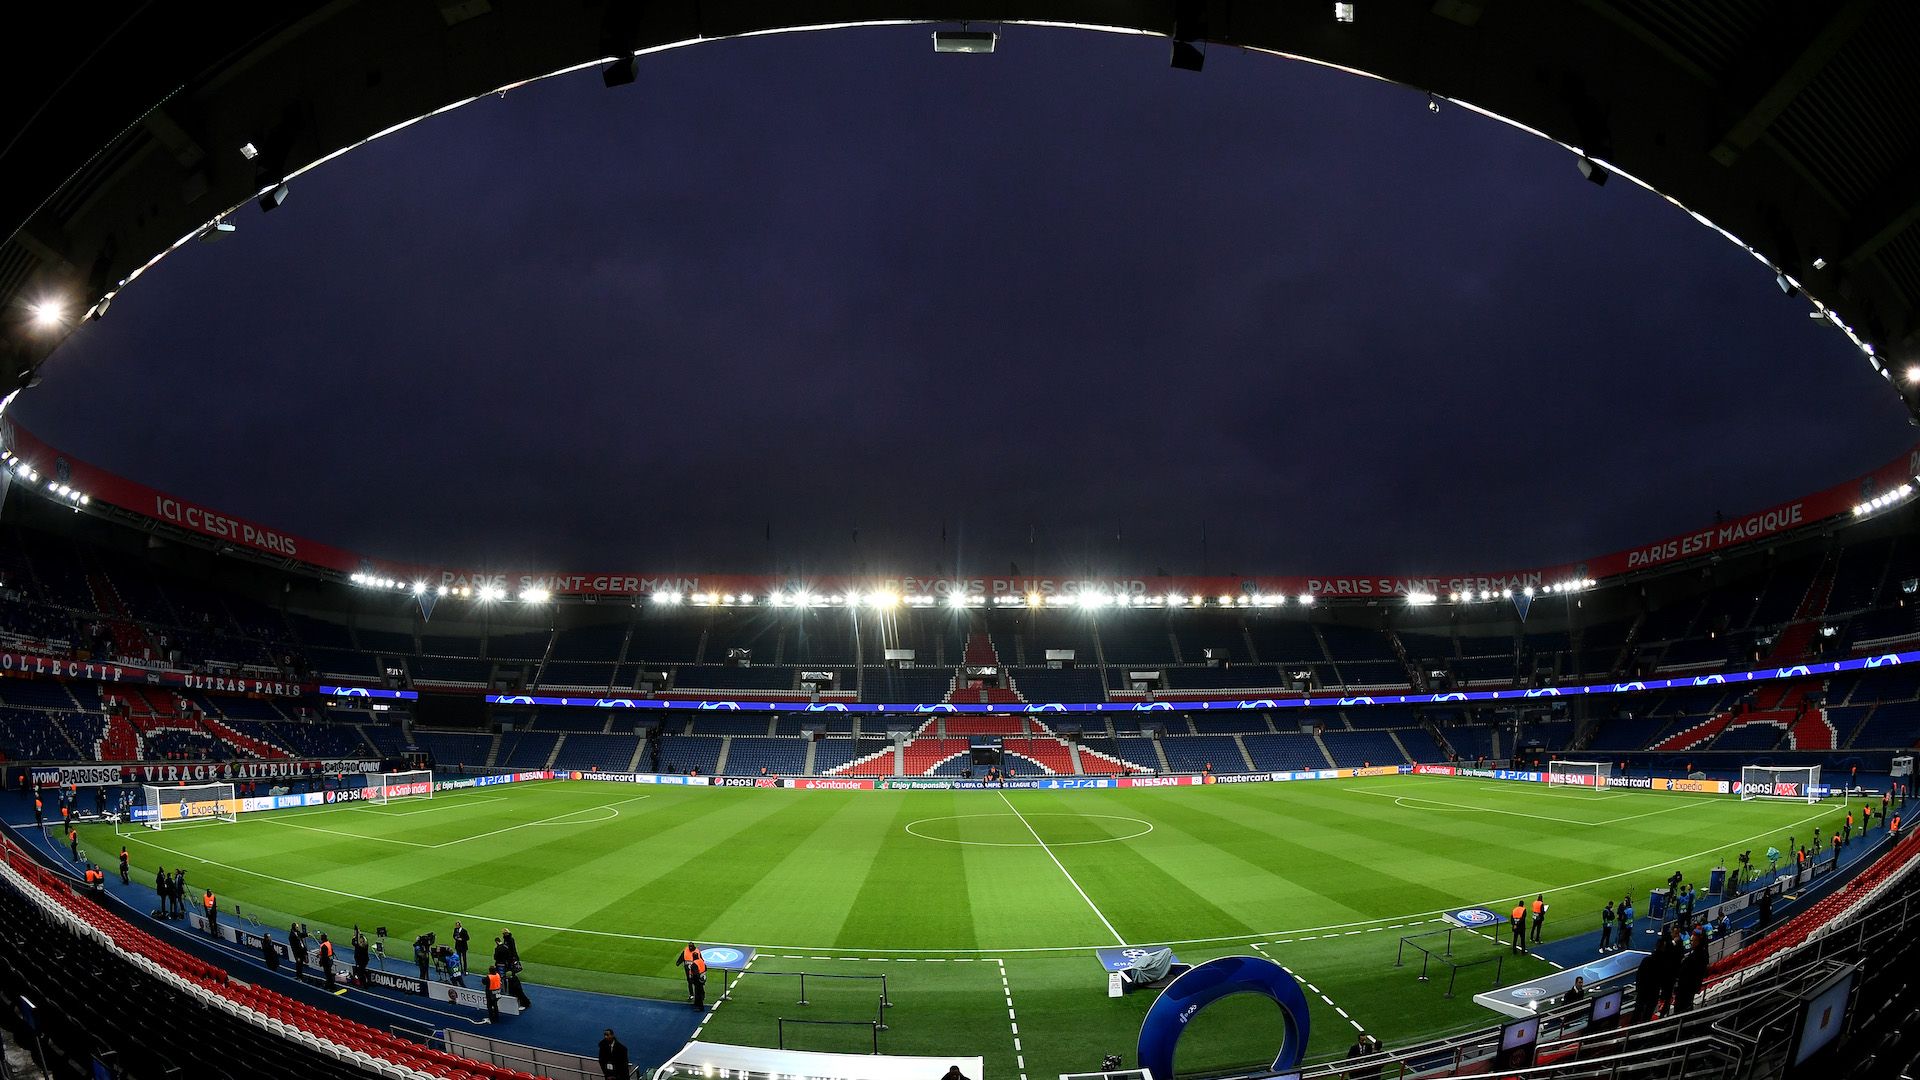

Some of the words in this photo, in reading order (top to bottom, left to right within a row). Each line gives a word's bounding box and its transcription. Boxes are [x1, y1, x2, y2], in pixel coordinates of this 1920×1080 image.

[156, 496, 181, 521] ICI
[186, 507, 238, 538] C'EST
[243, 525, 296, 555] PARIS
[1628, 541, 1678, 567] PARIS
[1682, 531, 1714, 554] EST
[1719, 504, 1802, 544] MAGIQUE
[442, 572, 506, 590] PARIS
[520, 576, 698, 592] SAINT-GERMAIN
[992, 579, 1054, 594] PLUS
[1308, 579, 1373, 593] PARIS
[1378, 571, 1542, 594] SAINT-GERMAIN
[185, 675, 246, 692] ULTRAS
[255, 681, 301, 697] PARIS
[144, 765, 219, 782] VIRAGE
[237, 762, 304, 778] AUTEUIL
[520, 771, 544, 781] NISSAN
[1426, 766, 1450, 775] Santander
[32, 772, 60, 785] MOMO
[487, 775, 504, 784] PS4
[584, 772, 634, 782] mastercard
[1218, 773, 1269, 784] mastercard
[1508, 772, 1528, 781] PS4
[1551, 774, 1584, 785] NISSAN
[1606, 776, 1650, 788] mastercard
[726, 778, 753, 787] pepsi
[755, 779, 778, 788] MAX
[815, 780, 862, 789] Santander
[892, 782, 910, 790] Enjoy
[911, 781, 951, 790] Responsibly
[1063, 780, 1094, 788] PS4
[1132, 778, 1178, 787] NISSAN
[1676, 780, 1703, 791] Expedia
[337, 789, 360, 800] pepsi
[1744, 782, 1773, 795] pepsi
[1774, 783, 1799, 796] MAX
